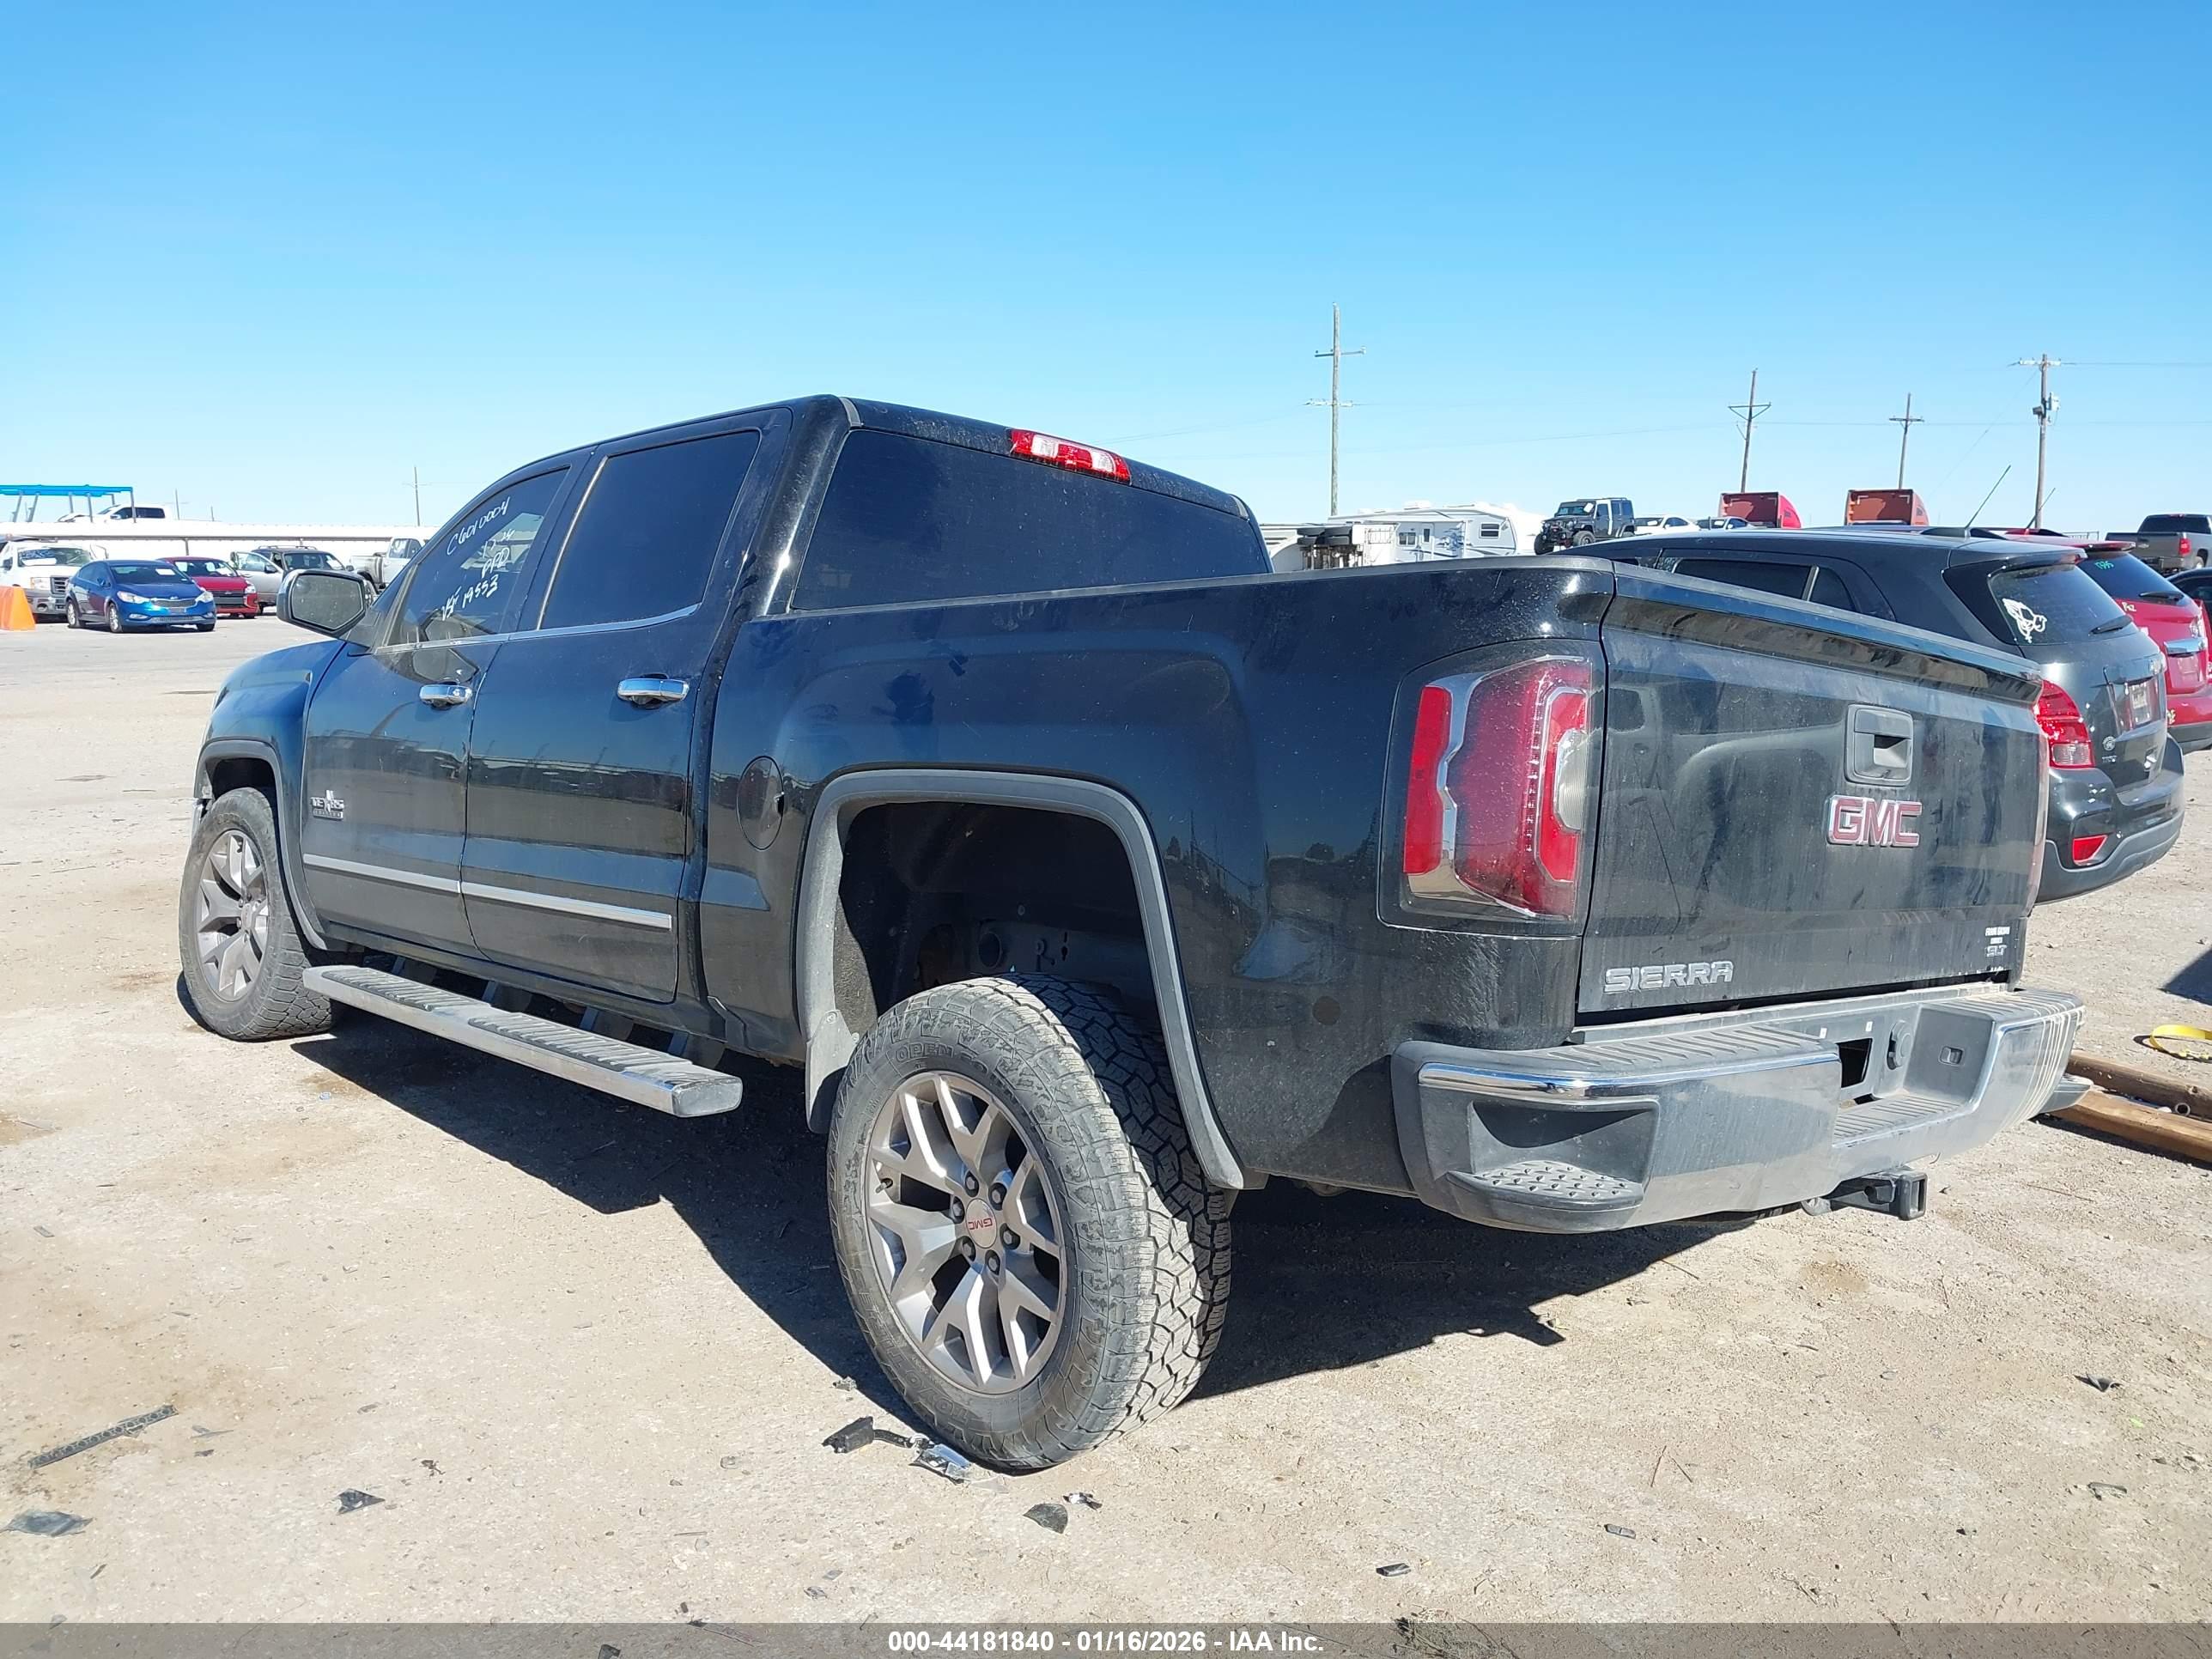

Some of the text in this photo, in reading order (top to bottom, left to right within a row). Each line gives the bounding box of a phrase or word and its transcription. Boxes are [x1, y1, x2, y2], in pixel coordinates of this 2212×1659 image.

[1828, 794, 1922, 847] GMC
[1604, 961, 1734, 994] SIERRA
[896, 1042, 955, 1062] OPEN
[968, 1218, 993, 1230] GMC
